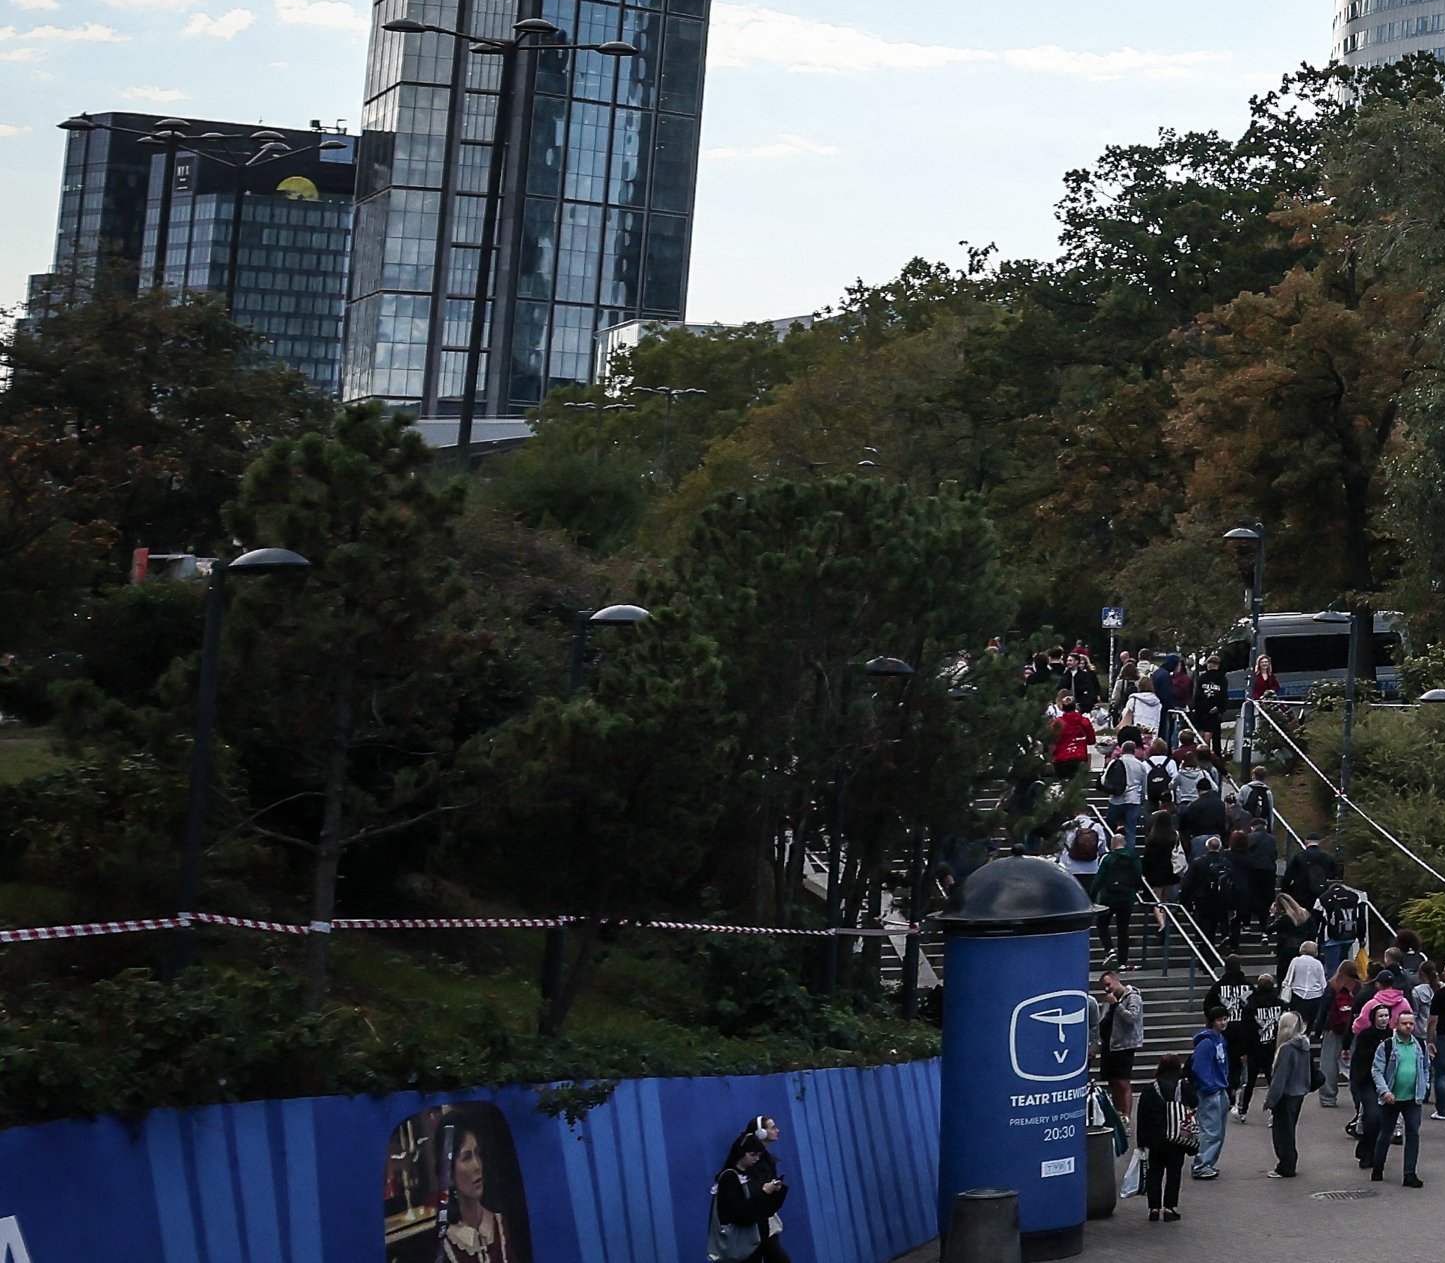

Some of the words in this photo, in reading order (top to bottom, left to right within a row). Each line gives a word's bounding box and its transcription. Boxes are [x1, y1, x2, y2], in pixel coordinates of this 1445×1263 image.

[1010, 1093, 1050, 1107] TEATR
[1009, 1116, 1050, 1126] PREMIERY
[1044, 1125, 1075, 1141] 20:30
